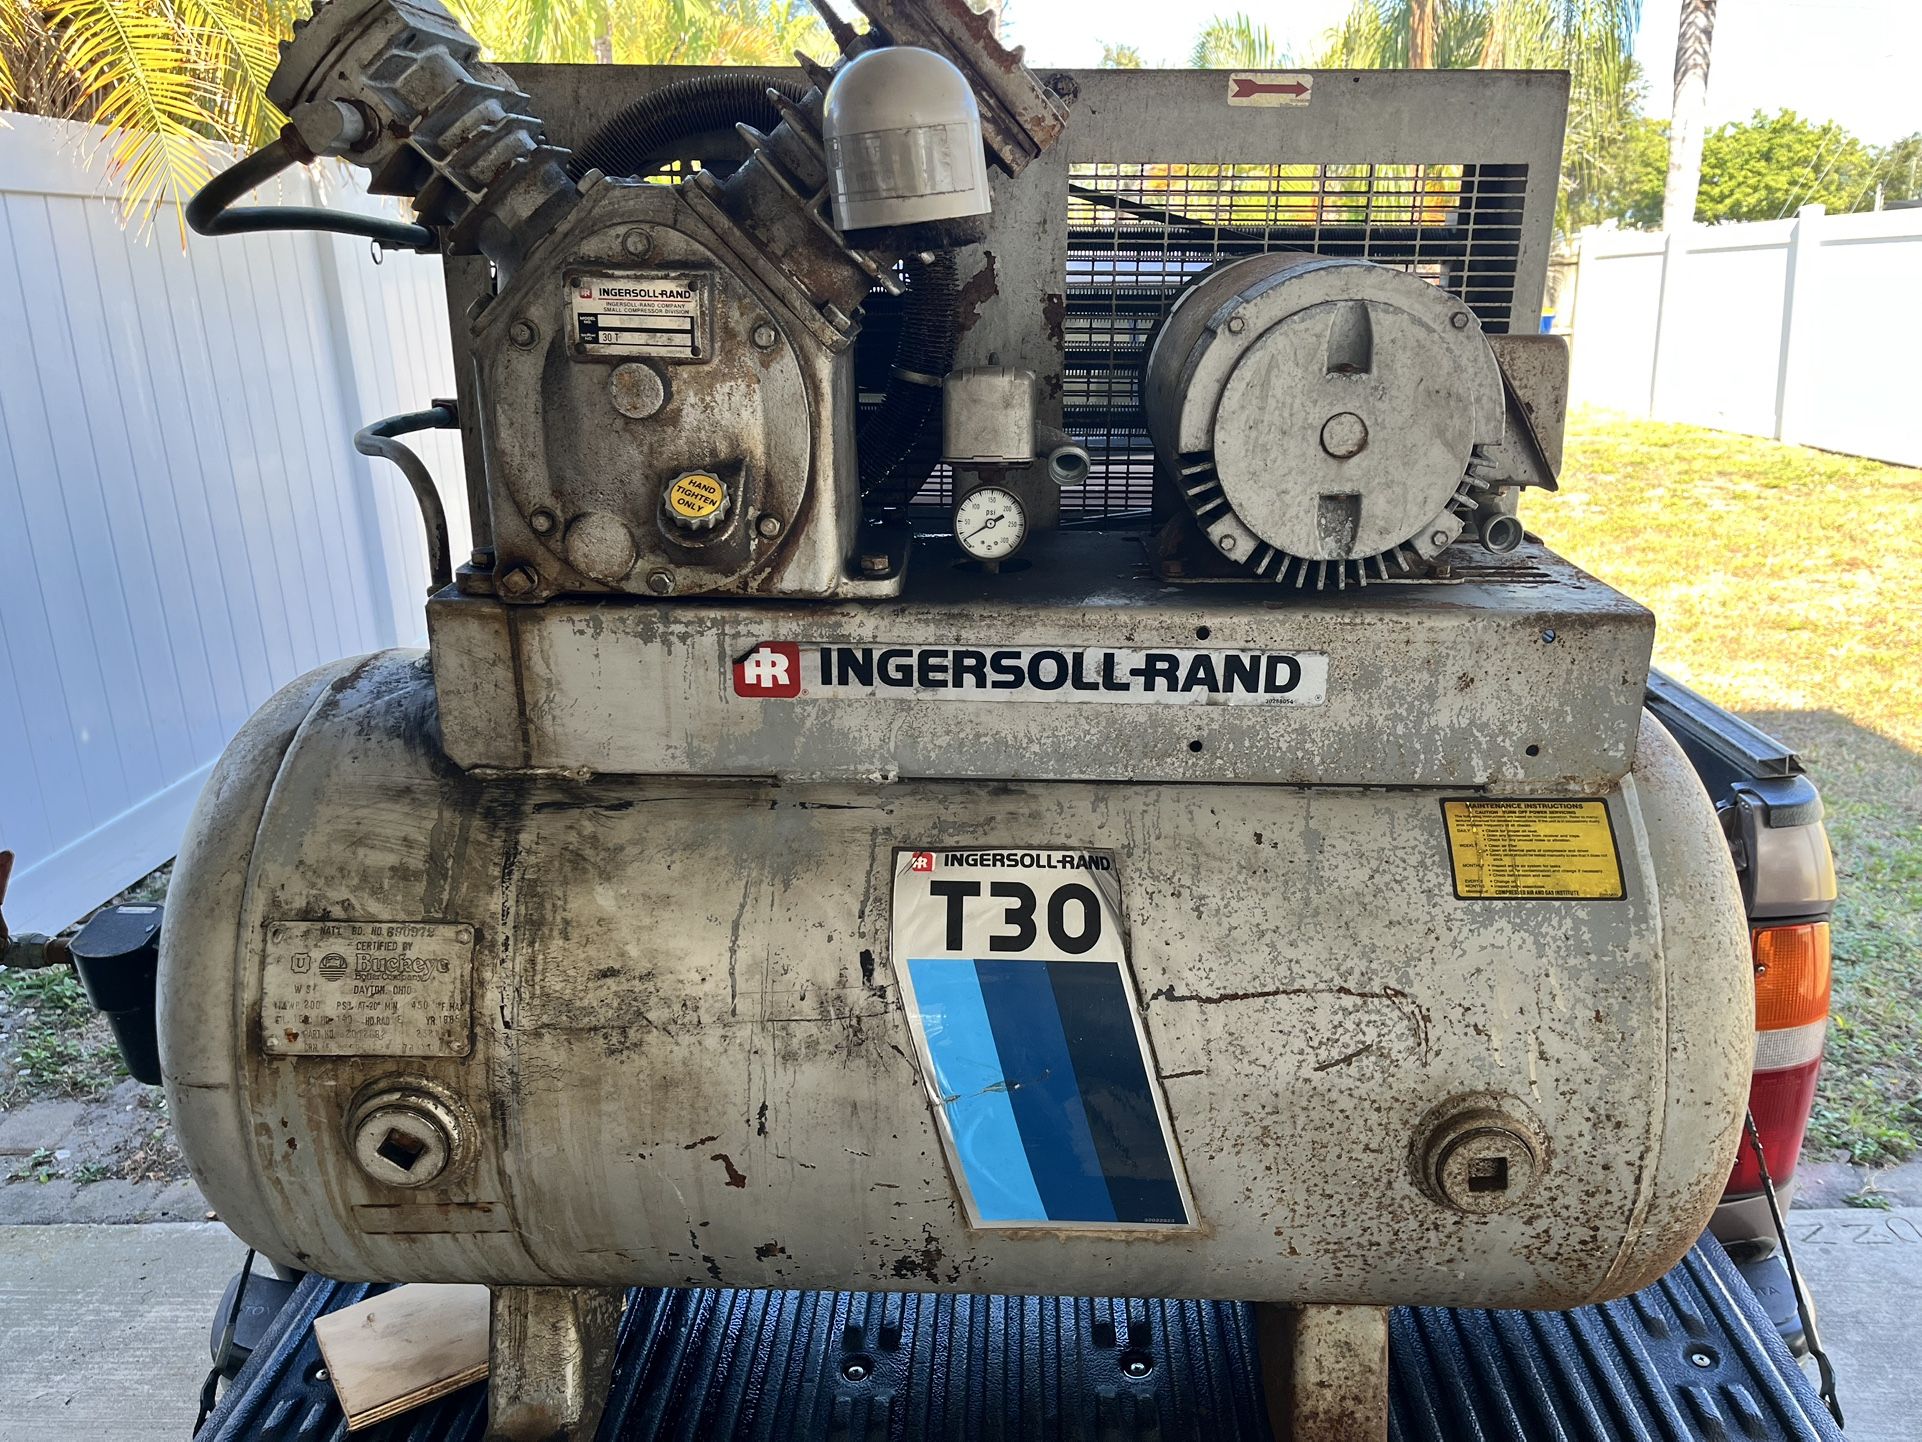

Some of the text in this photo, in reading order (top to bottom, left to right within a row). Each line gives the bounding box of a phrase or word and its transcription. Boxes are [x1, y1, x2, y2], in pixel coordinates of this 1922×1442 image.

[599, 288, 691, 299] INGERSOLL-RAND
[688, 479, 716, 494] HAND
[676, 485, 718, 507] TIGHTEN
[677, 498, 705, 512] ONLY
[820, 647, 1301, 694] INGERSOLL-RAND
[1465, 802, 1523, 810] MAINTENANCE
[944, 853, 1111, 871] INGERSOLL-RAND
[930, 880, 1102, 954] T30
[356, 941, 413, 951] CERTIFIED BY
[354, 953, 450, 982] Buckeye
[393, 985, 412, 995] OHIO
[304, 1000, 321, 1010] 200
[411, 1002, 429, 1010] 450
